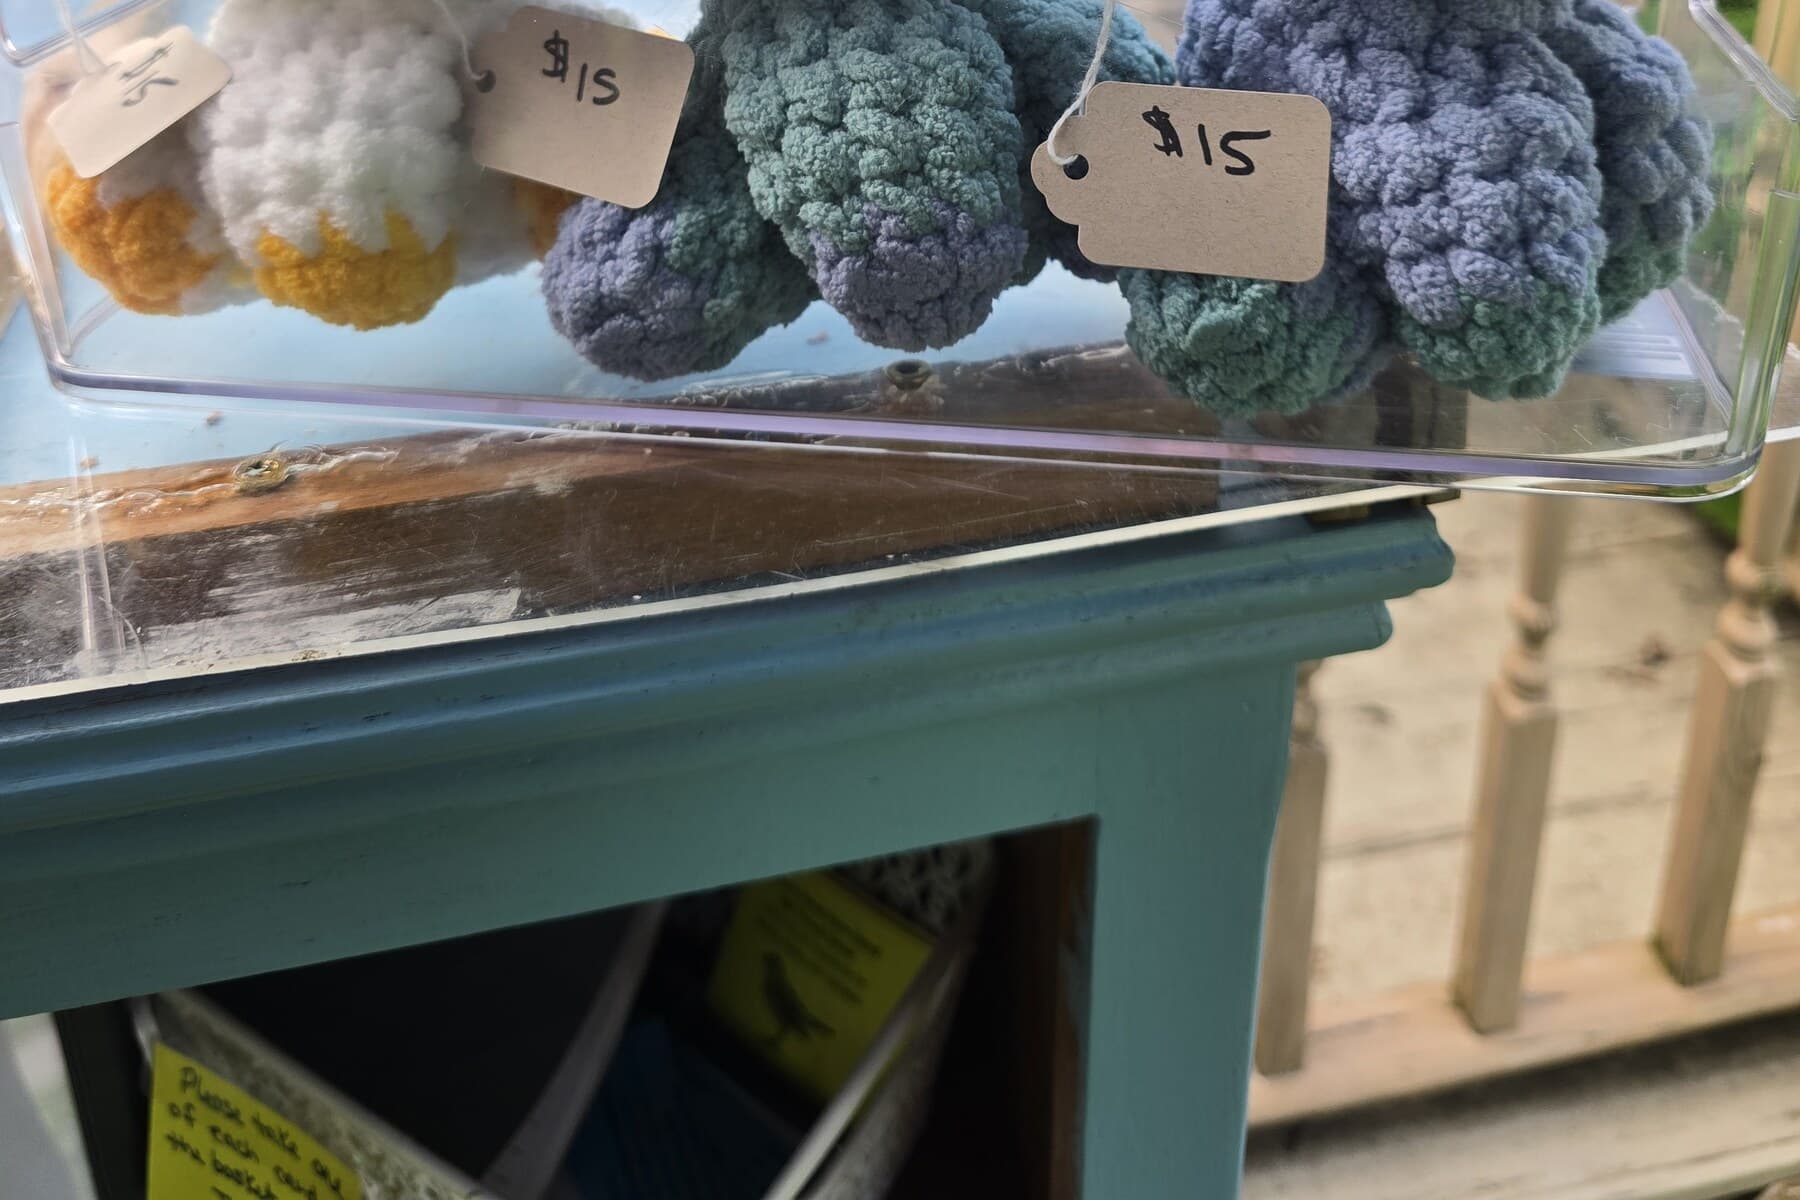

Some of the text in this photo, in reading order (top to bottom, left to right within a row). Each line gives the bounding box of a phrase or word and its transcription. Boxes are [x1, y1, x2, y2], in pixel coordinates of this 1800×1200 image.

[542, 29, 621, 106] $15
[1141, 104, 1272, 177] $15
[167, 1102, 196, 1128] of
[179, 1066, 245, 1127] Please
